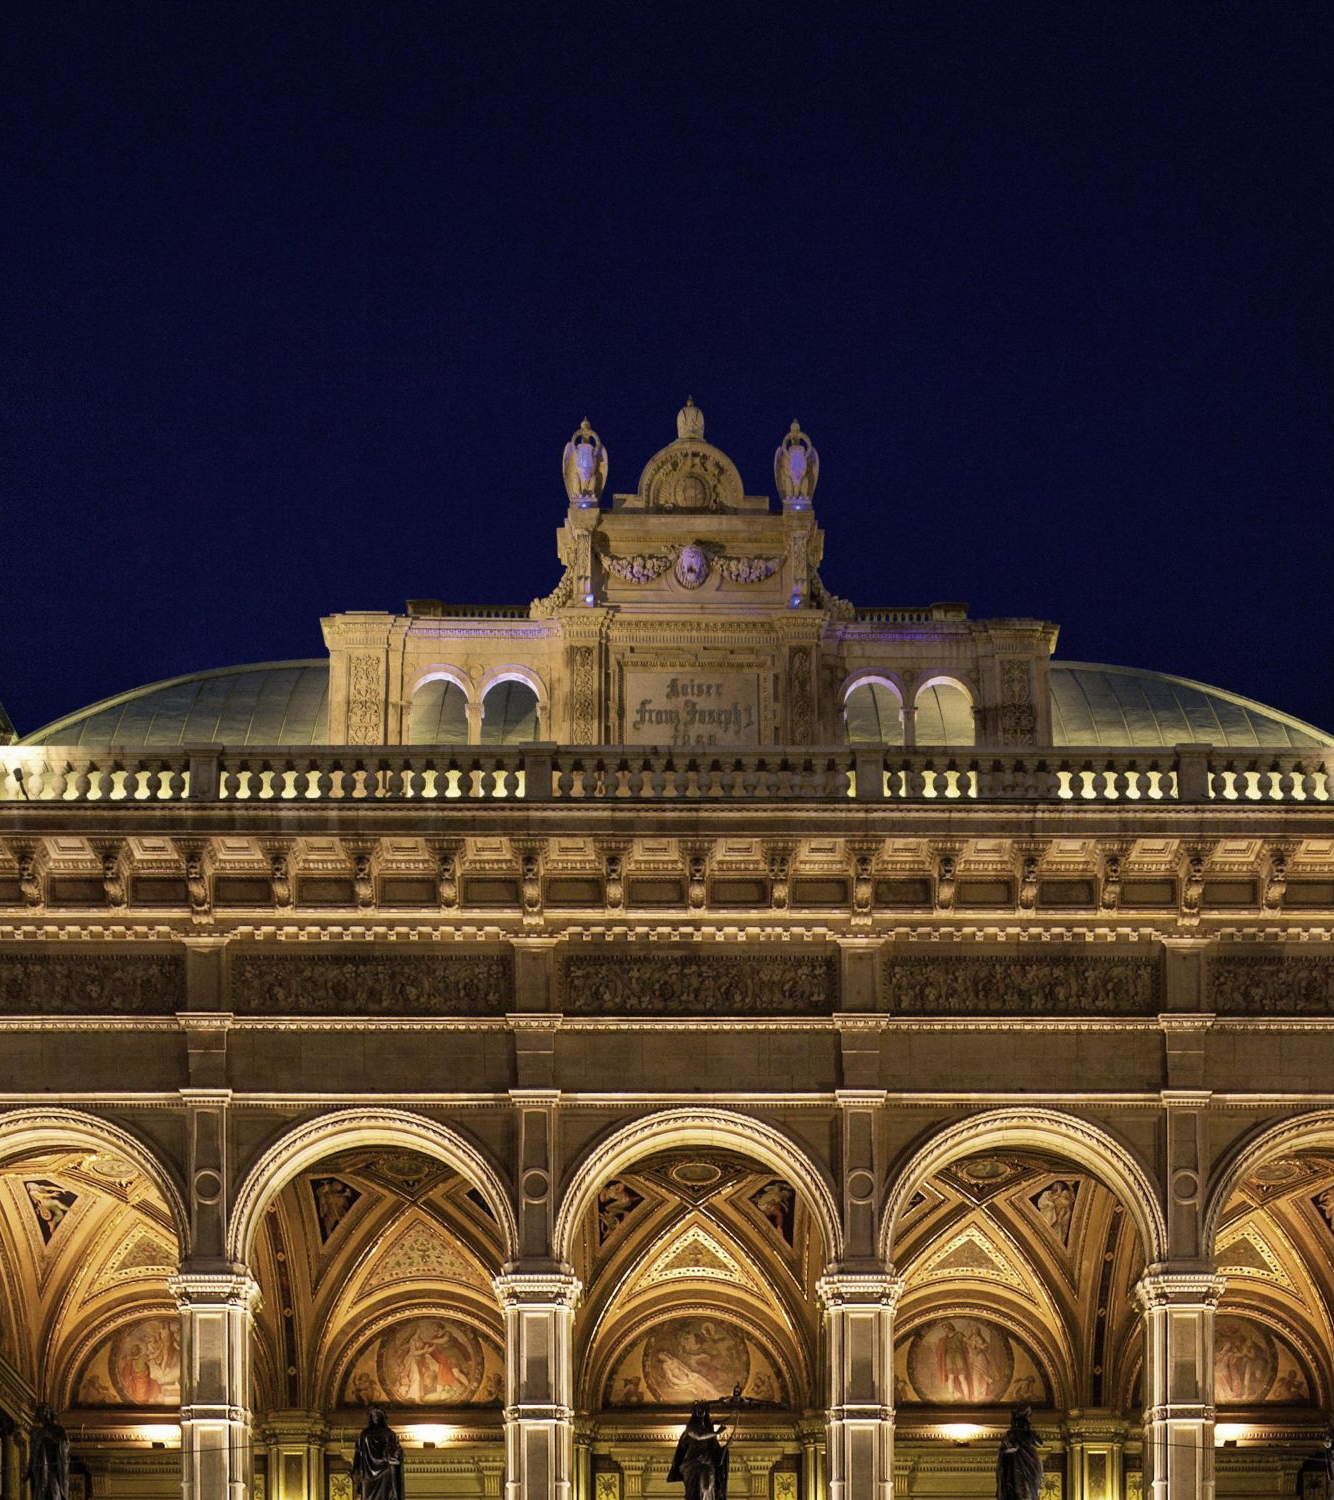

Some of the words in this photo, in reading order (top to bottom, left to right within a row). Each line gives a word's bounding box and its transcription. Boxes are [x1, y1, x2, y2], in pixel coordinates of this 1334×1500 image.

[666, 678, 724, 699] Kaiser
[632, 698, 680, 732] Franz
[682, 698, 742, 735] Joseph
